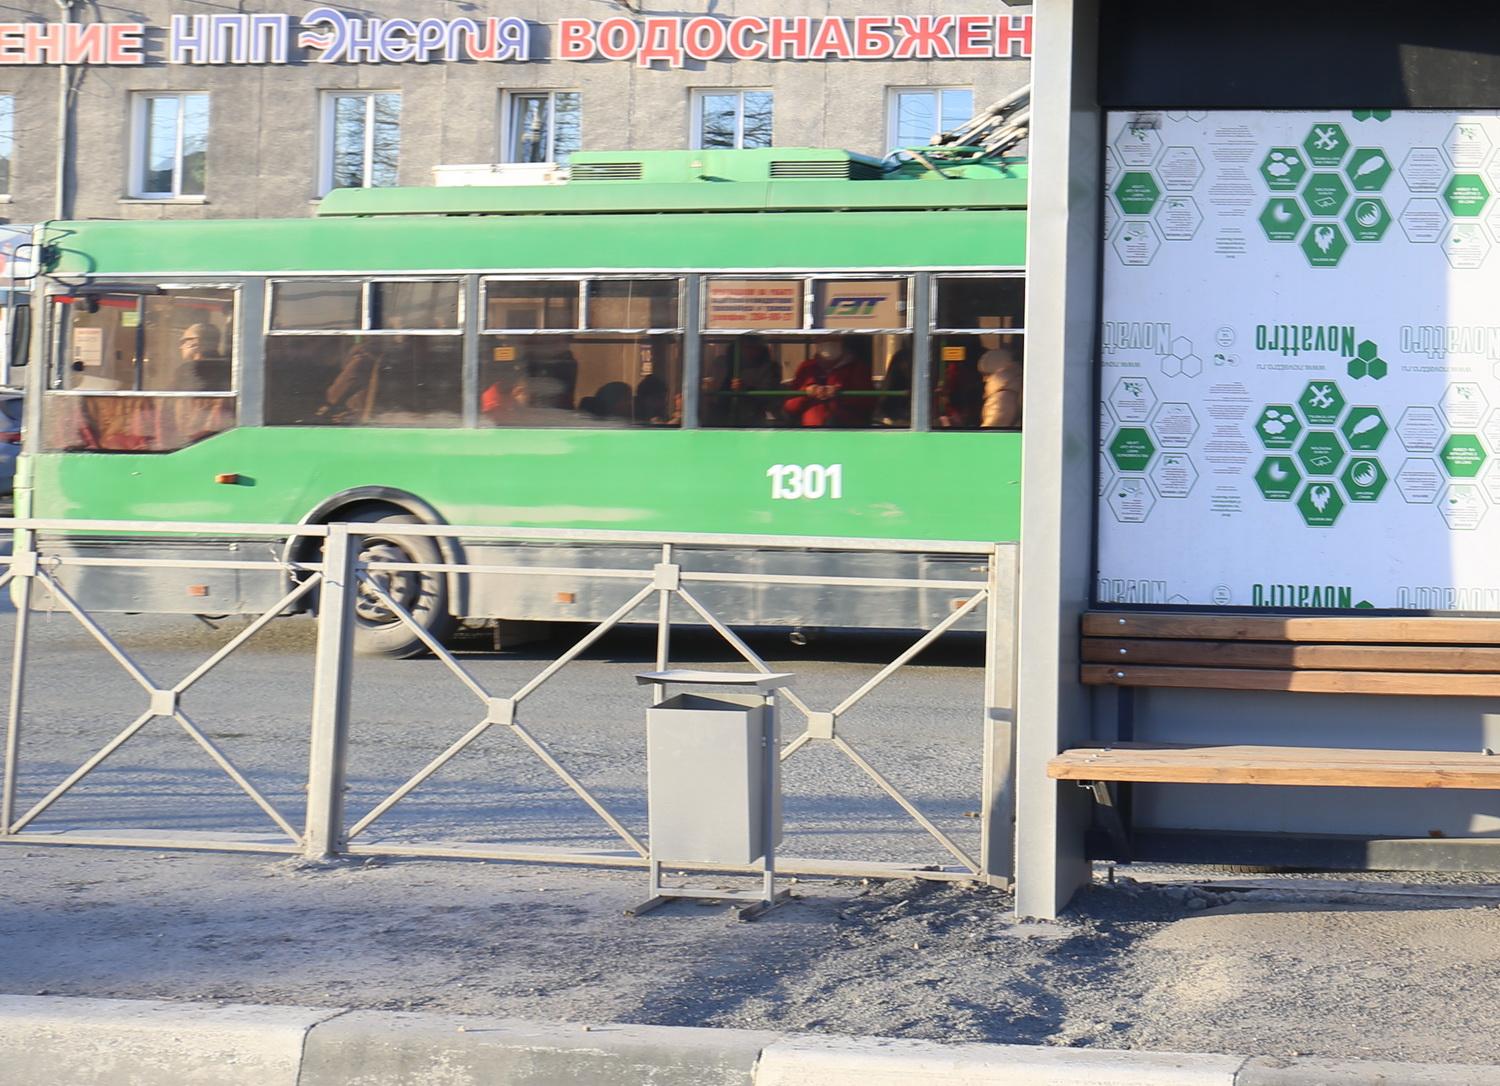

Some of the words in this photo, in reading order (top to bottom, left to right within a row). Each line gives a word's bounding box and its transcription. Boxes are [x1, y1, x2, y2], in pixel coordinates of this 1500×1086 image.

[170, 13, 290, 65] НПП
[557, 15, 1033, 68] ВОДОСНАБЖЕН
[1256, 324, 1355, 357] Novattro
[767, 464, 842, 499] 1301
